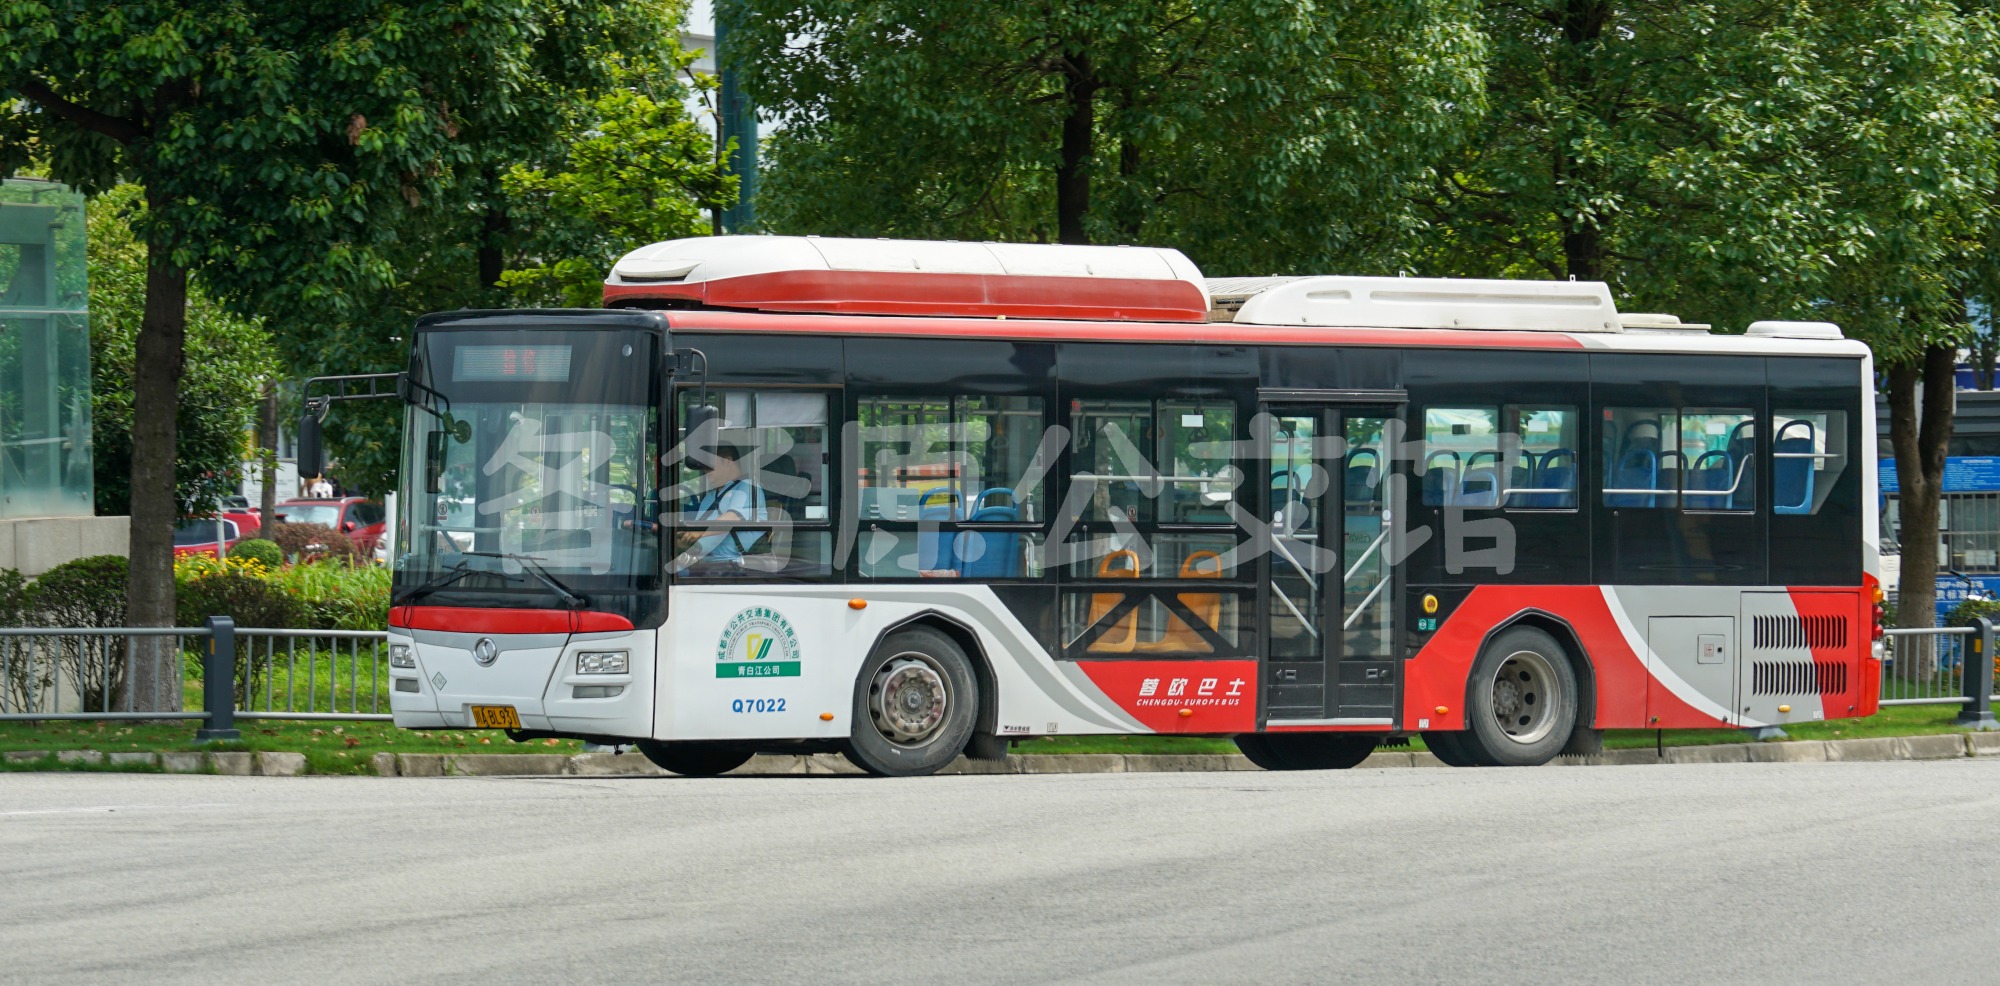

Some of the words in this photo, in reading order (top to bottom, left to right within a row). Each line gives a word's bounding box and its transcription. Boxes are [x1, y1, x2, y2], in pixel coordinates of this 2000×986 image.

[717, 607, 800, 660] 成都市公共交通集团有限公司
[738, 665, 780, 676] 青白江公司
[1139, 678, 1245, 696] 蓉欧巴士
[732, 698, 786, 713] Q7022
[1221, 698, 1240, 706] BUS
